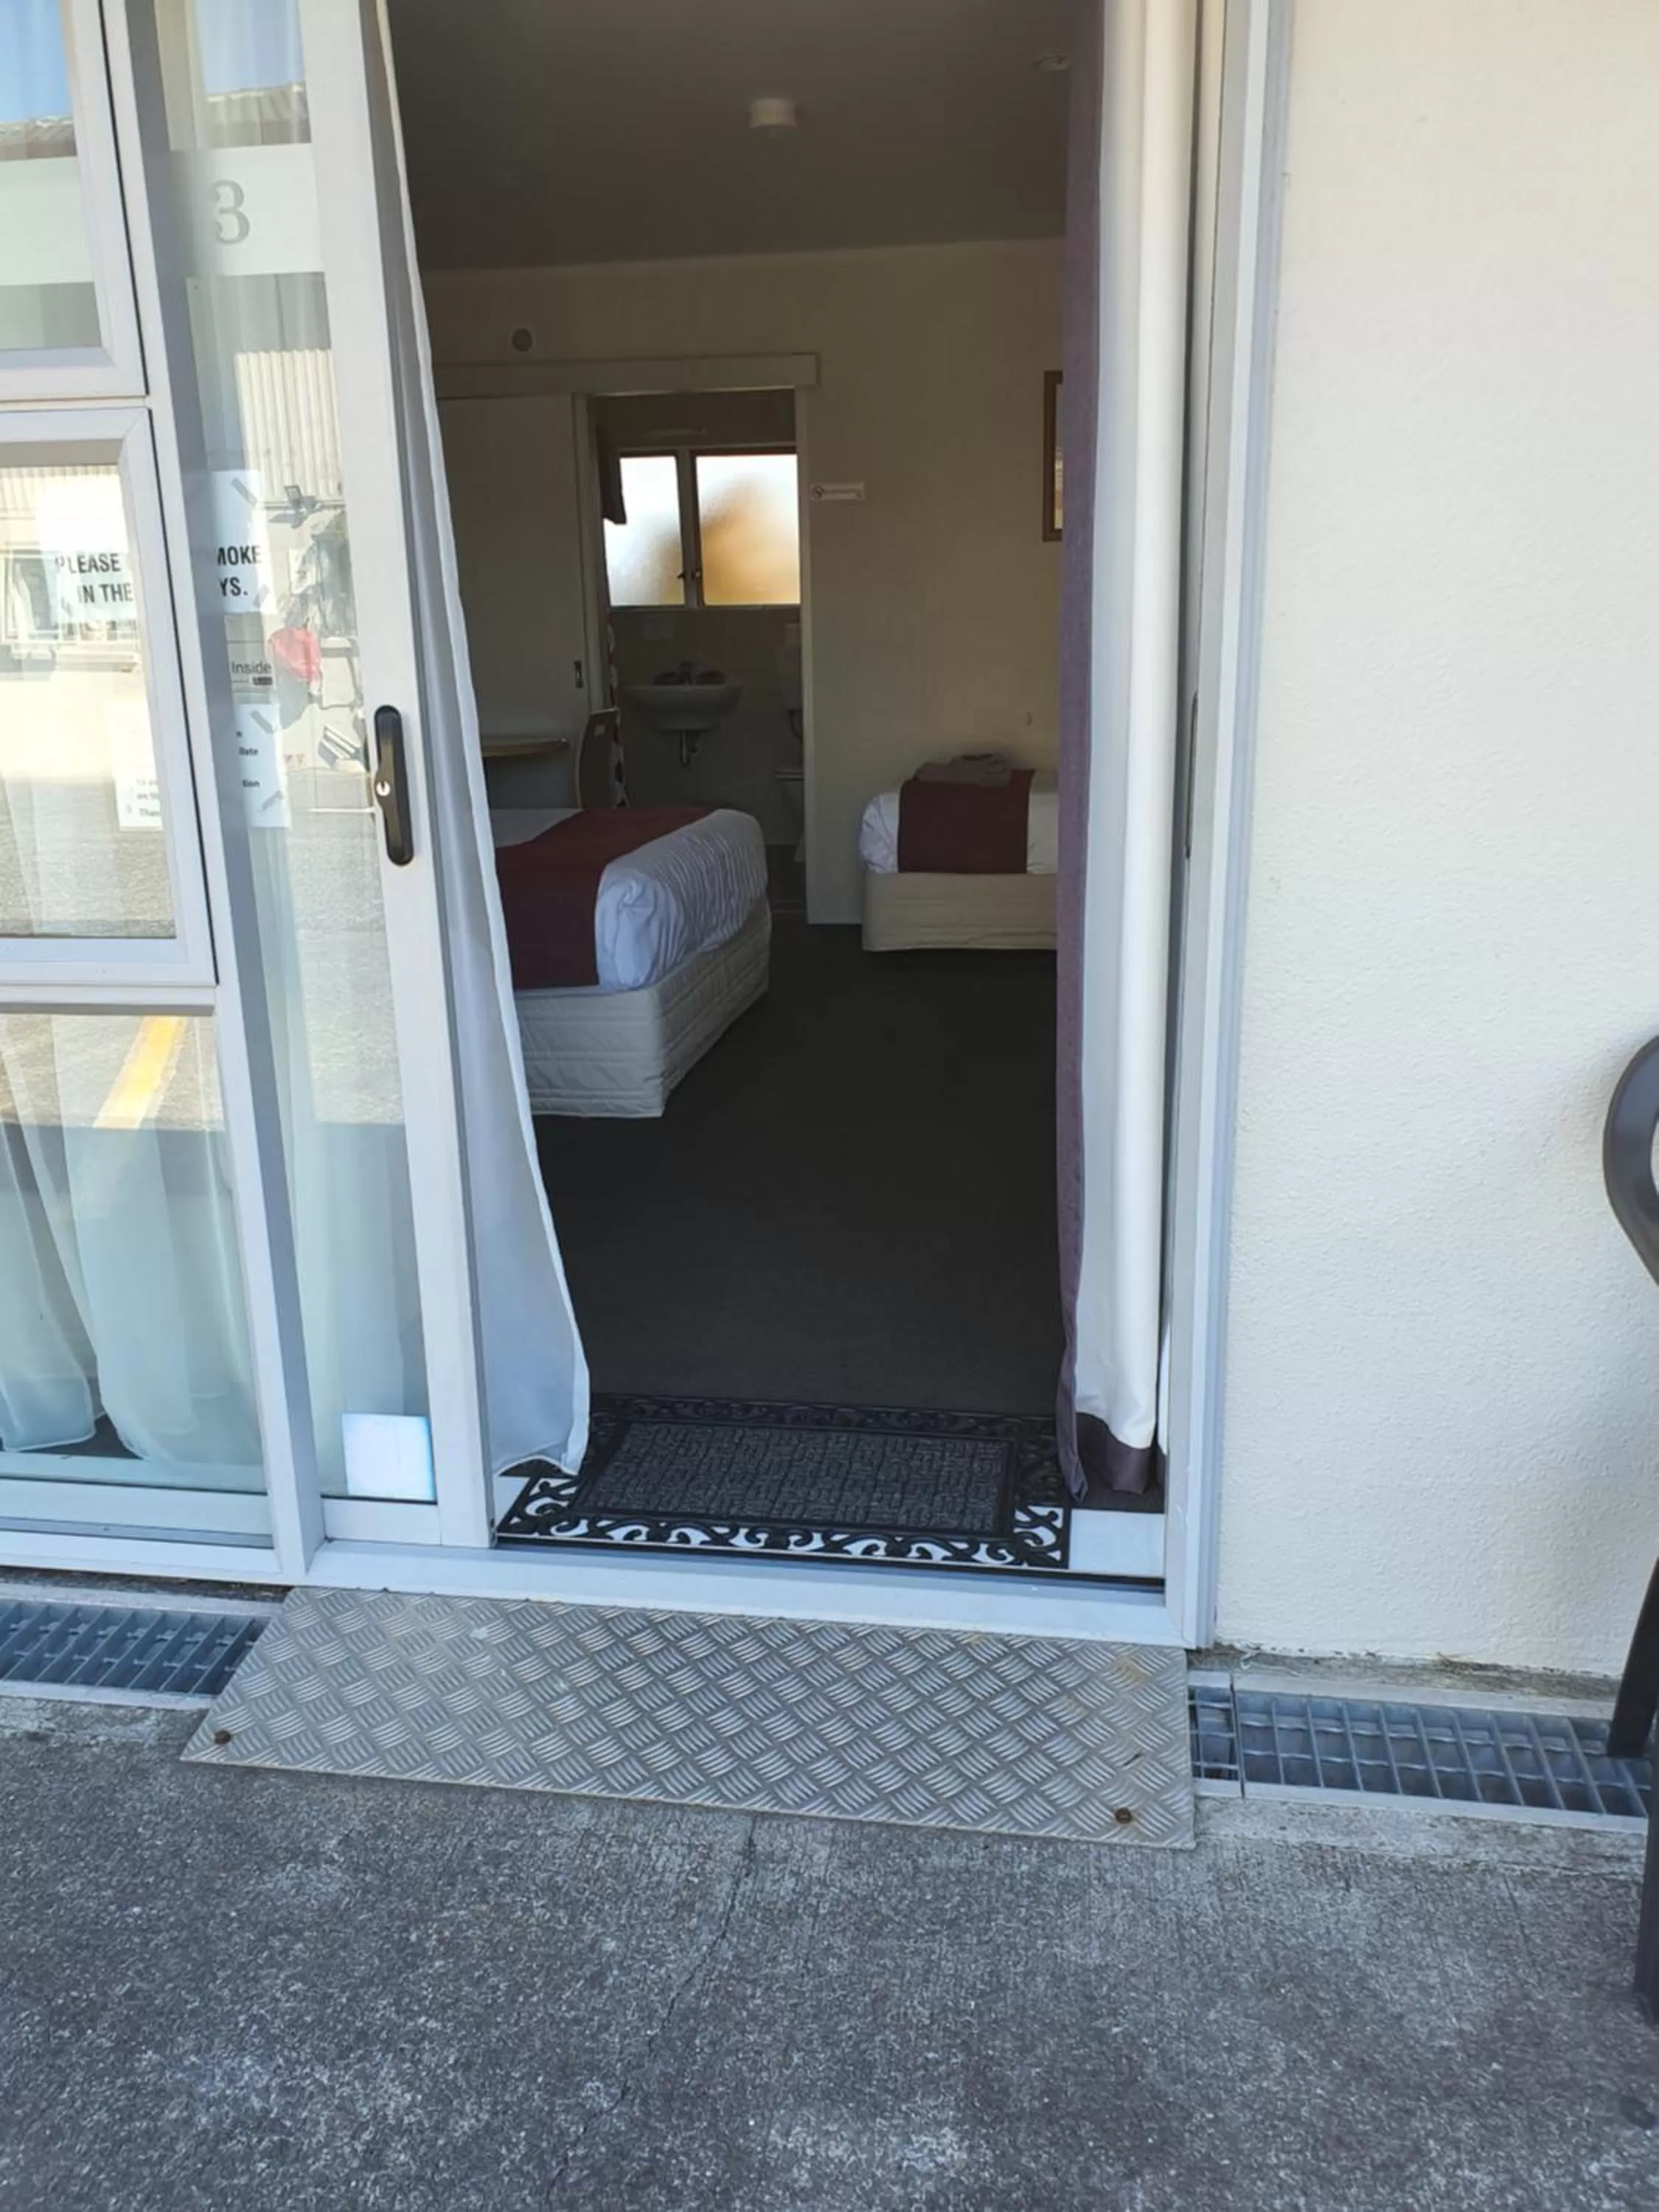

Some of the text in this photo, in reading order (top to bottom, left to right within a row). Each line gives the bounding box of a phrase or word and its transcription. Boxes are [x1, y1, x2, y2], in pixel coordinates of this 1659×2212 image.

[209, 180, 250, 246] 3
[55, 553, 121, 574] PLEASE
[77, 584, 95, 603] IN
[98, 582, 133, 602] THE
[231, 660, 272, 674] Inside
